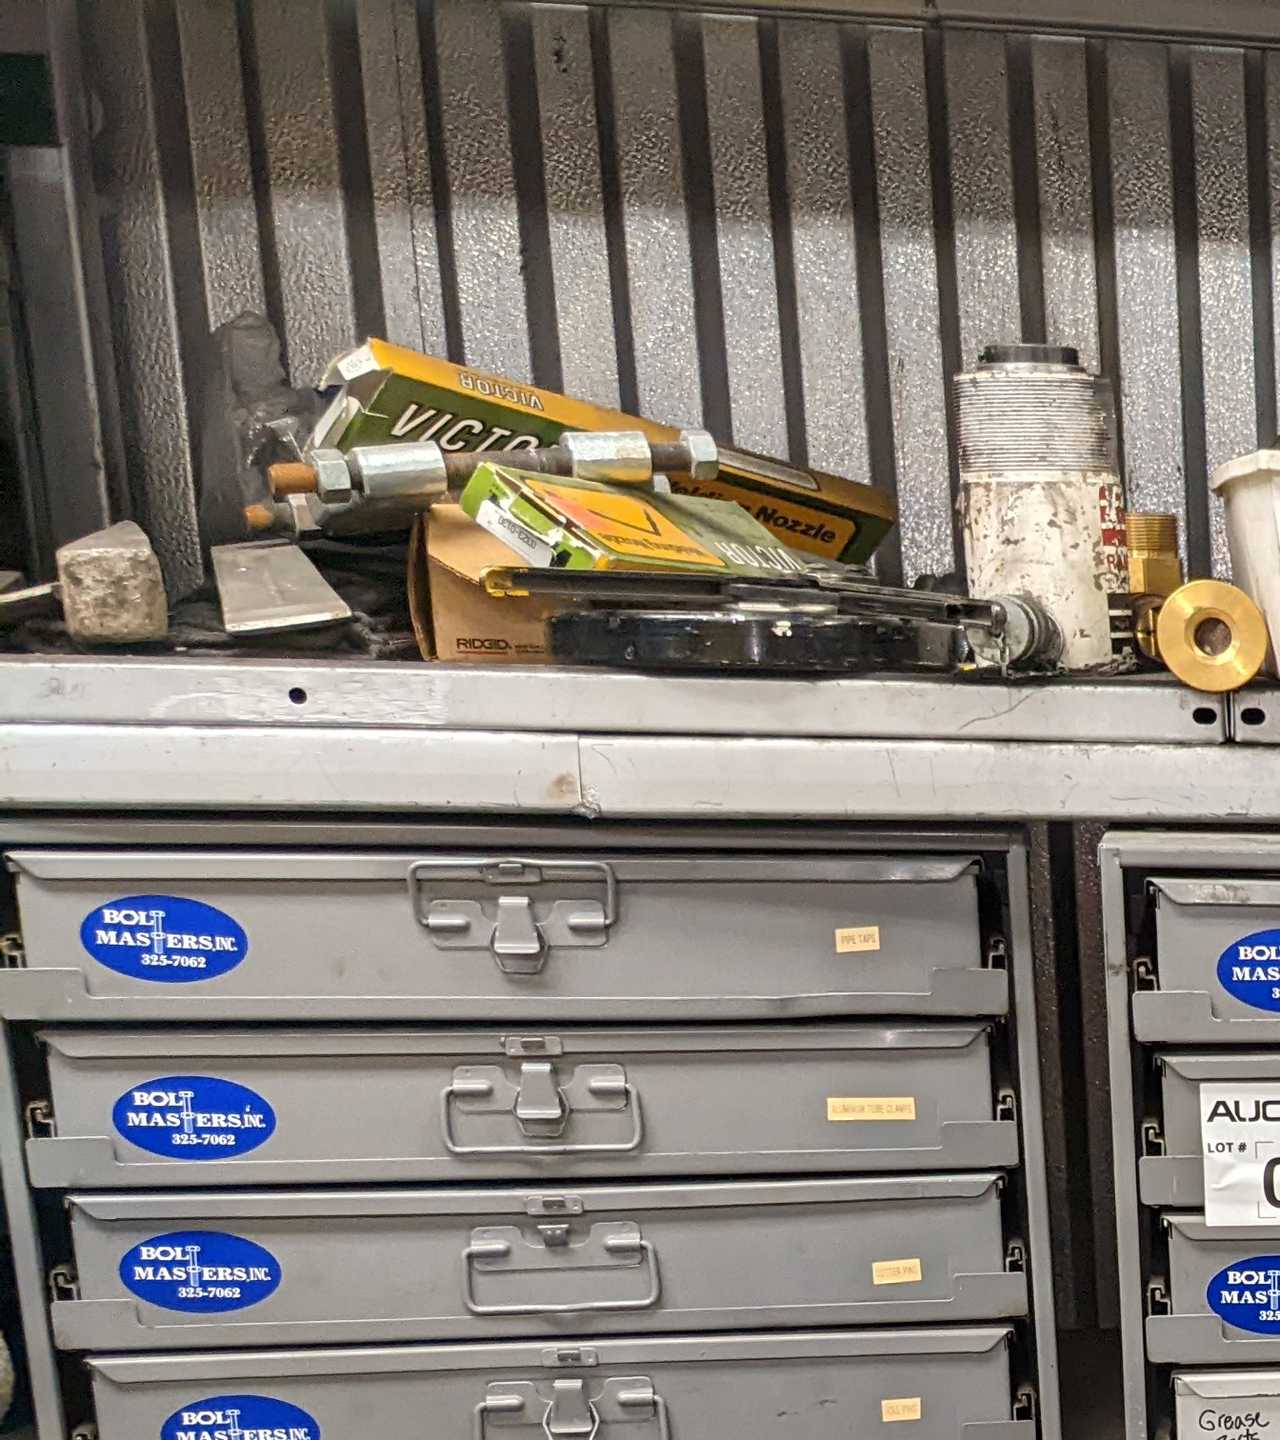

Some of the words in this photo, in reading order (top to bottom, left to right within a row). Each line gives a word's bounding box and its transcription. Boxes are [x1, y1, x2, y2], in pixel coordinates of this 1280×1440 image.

[390, 402, 556, 453] VICTO
[754, 505, 837, 544] Nozzle
[141, 953, 206, 968] 325-7062
[171, 1133, 235, 1145] 325-7062
[1207, 1142, 1235, 1153] LOT
[177, 1287, 240, 1298] 325-7062
[1199, 1409, 1270, 1431] Grease
